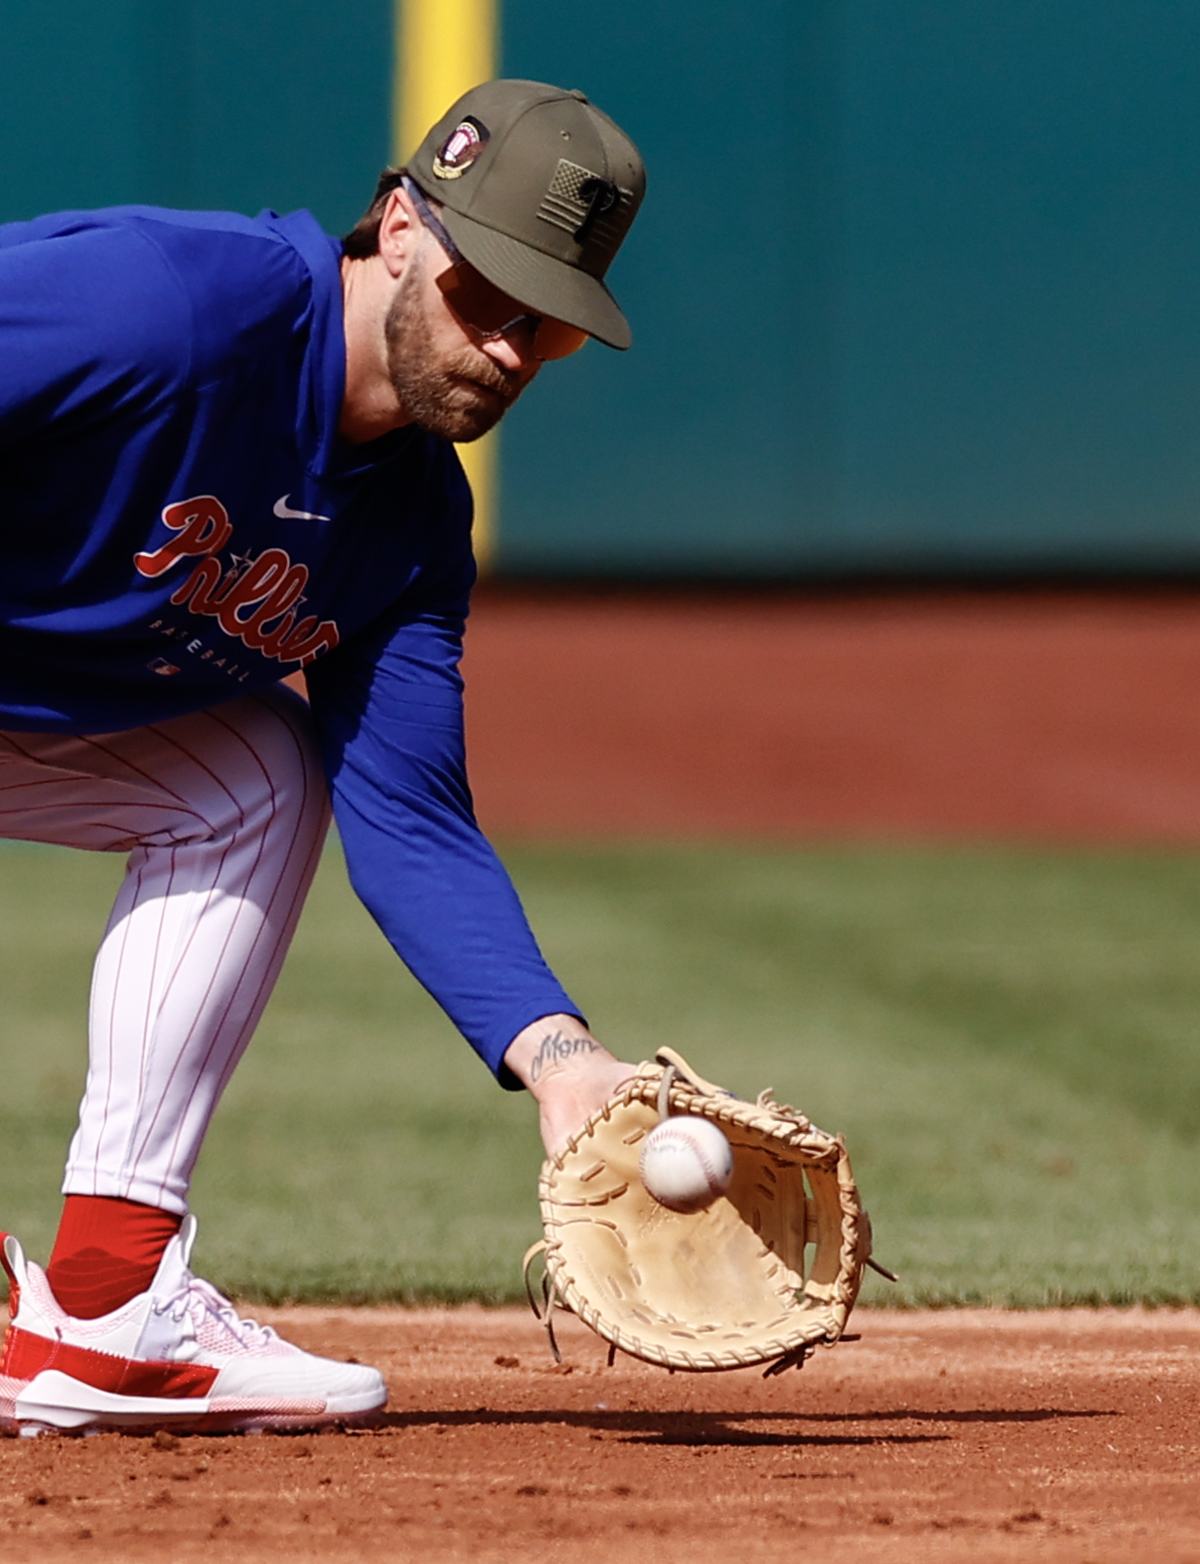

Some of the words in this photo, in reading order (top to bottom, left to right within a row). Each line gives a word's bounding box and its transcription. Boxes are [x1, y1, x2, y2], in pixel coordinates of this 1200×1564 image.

[573, 177, 620, 245] P
[148, 619, 250, 682] BASEBALL
[530, 1030, 600, 1083] Mom
